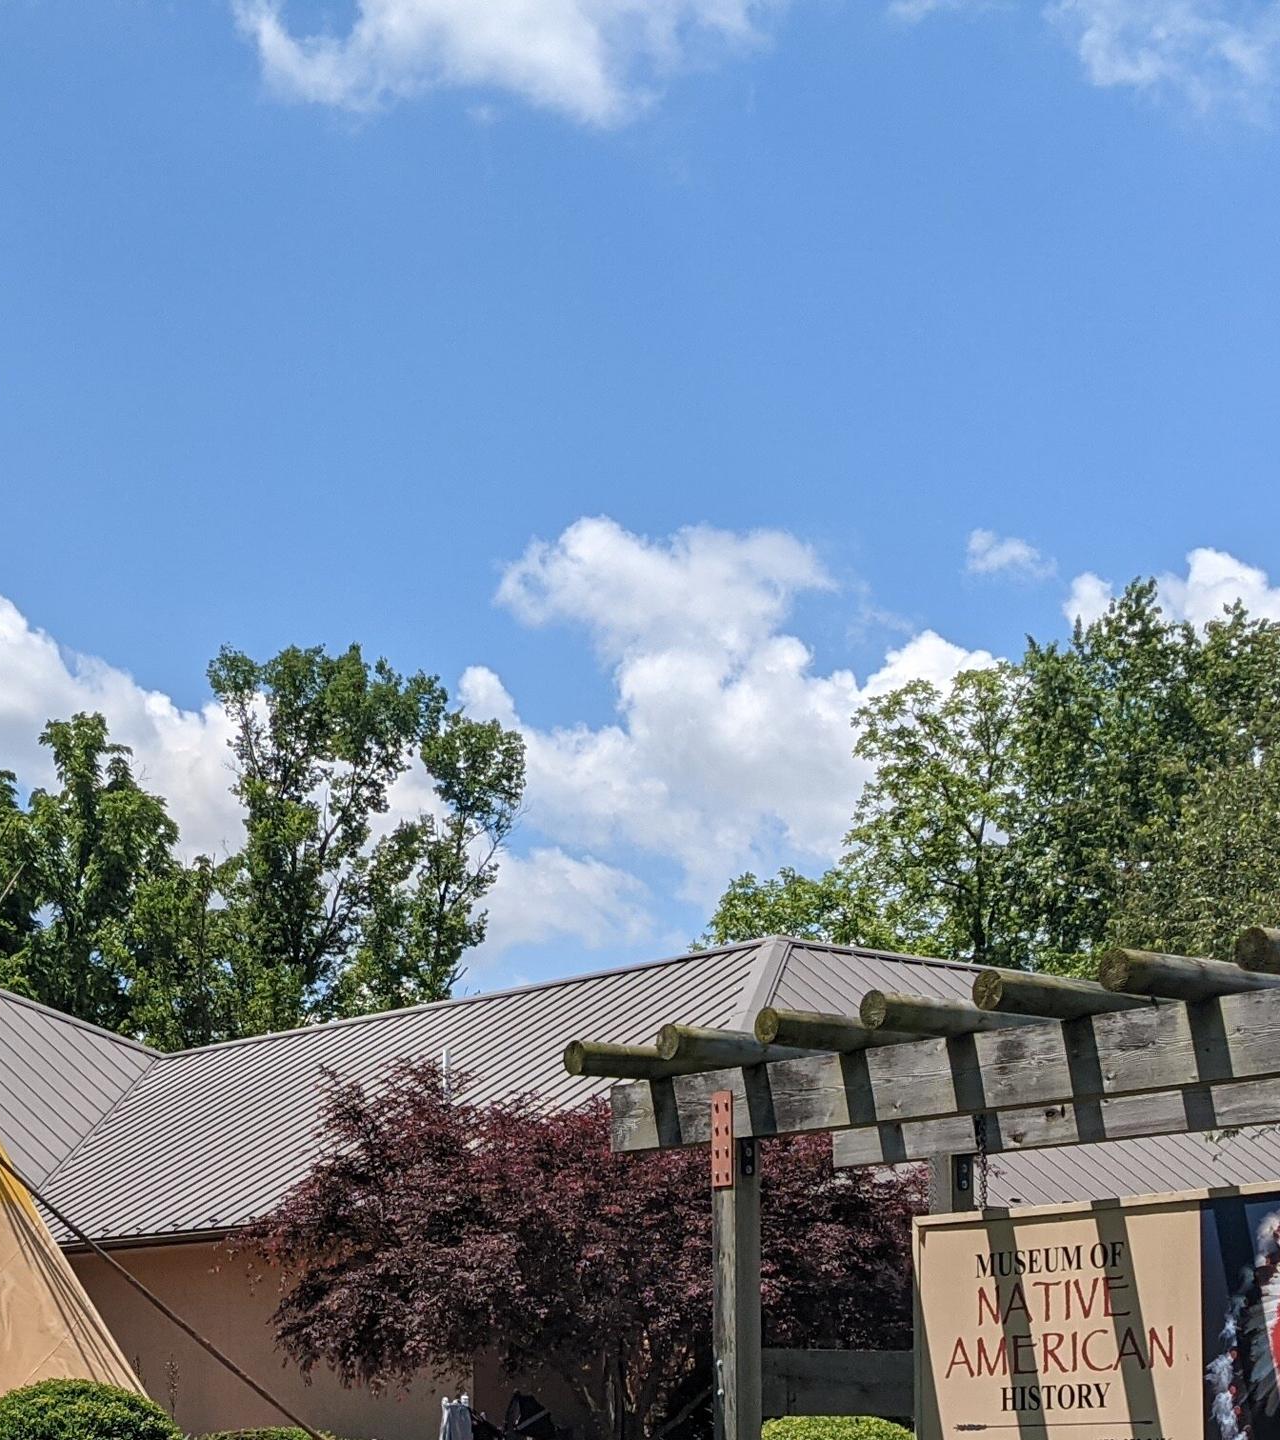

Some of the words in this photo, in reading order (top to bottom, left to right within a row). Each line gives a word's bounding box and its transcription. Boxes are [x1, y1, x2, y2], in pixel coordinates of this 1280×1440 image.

[975, 1245, 1083, 1278] MUSEUM
[1090, 1242, 1124, 1269] OF
[978, 1276, 1131, 1326] NATIVE
[945, 1325, 1174, 1379] AMERICAN
[1001, 1383, 1111, 1411] HISTORY
